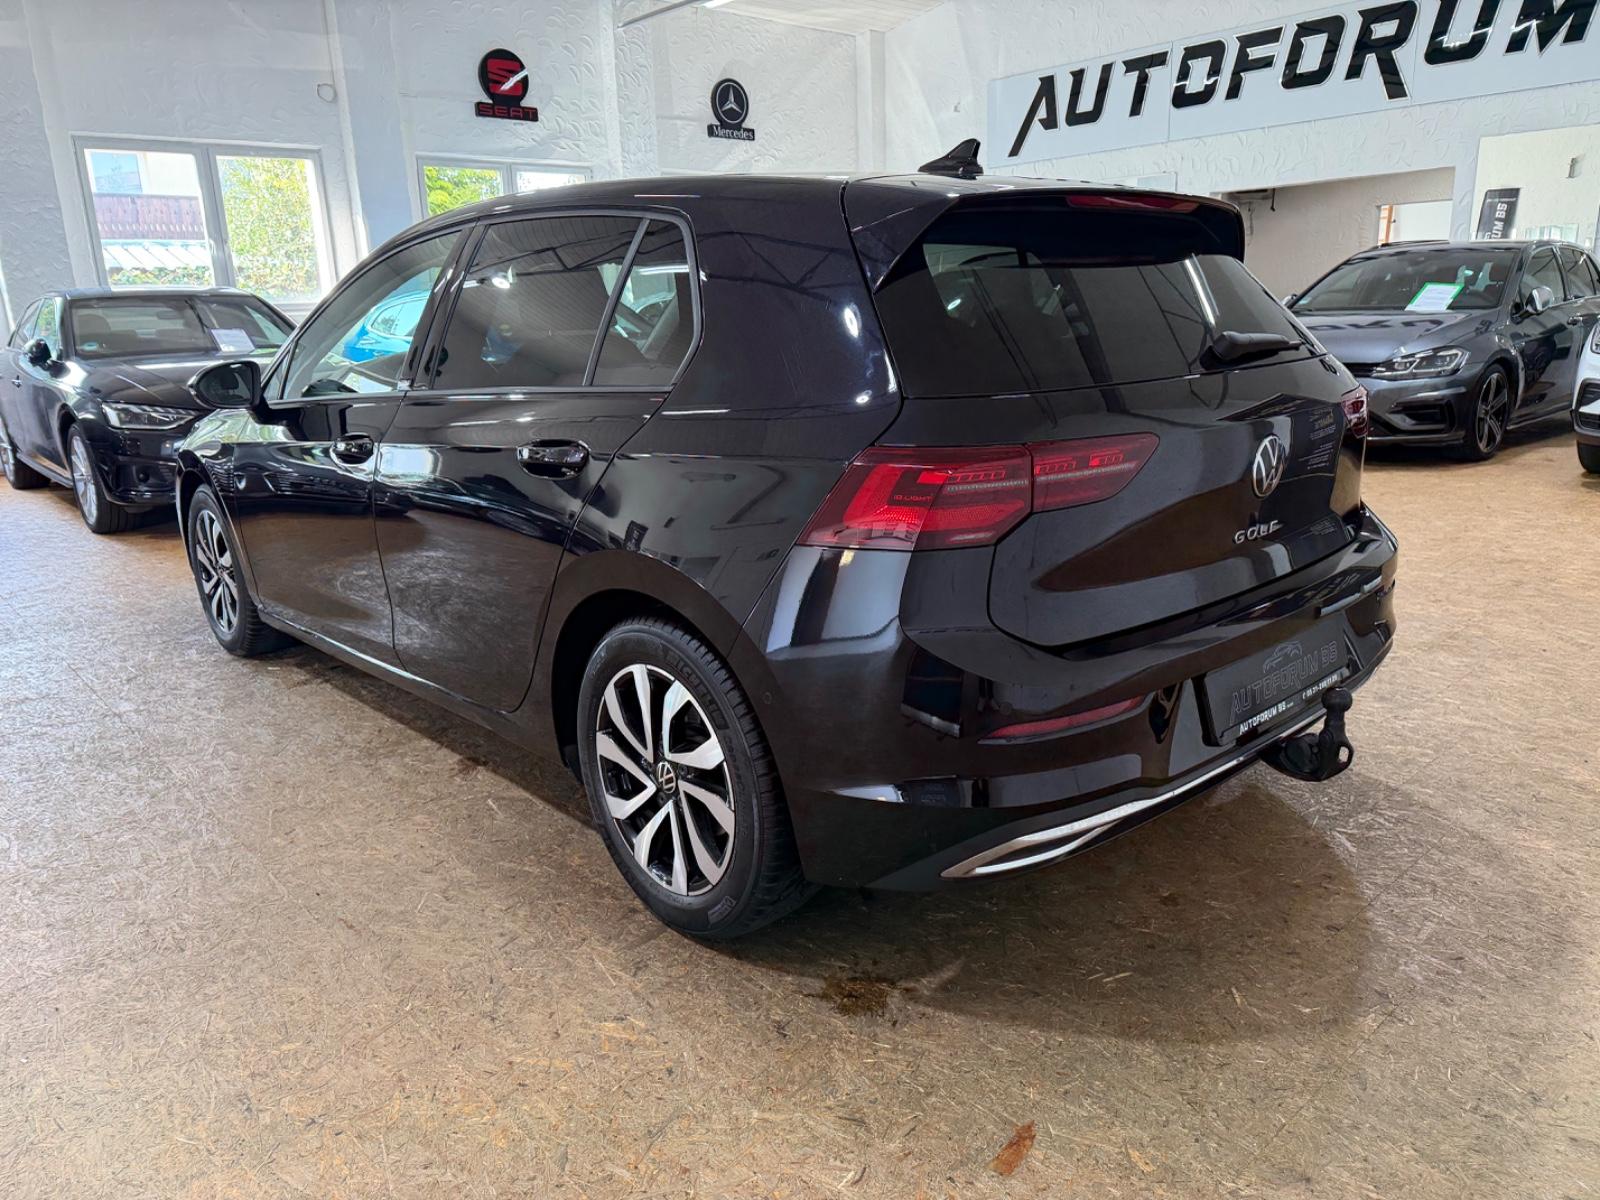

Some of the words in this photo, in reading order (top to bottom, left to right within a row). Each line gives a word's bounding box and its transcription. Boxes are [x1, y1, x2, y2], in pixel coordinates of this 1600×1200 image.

[1007, 0, 1598, 157] AUTOFORUM
[478, 103, 537, 120] SEAT
[713, 125, 754, 140] Mercedes
[1234, 519, 1279, 545] GOLF
[1230, 650, 1319, 726] AUTOFORUM
[1239, 705, 1277, 735] AUTOFORUM
